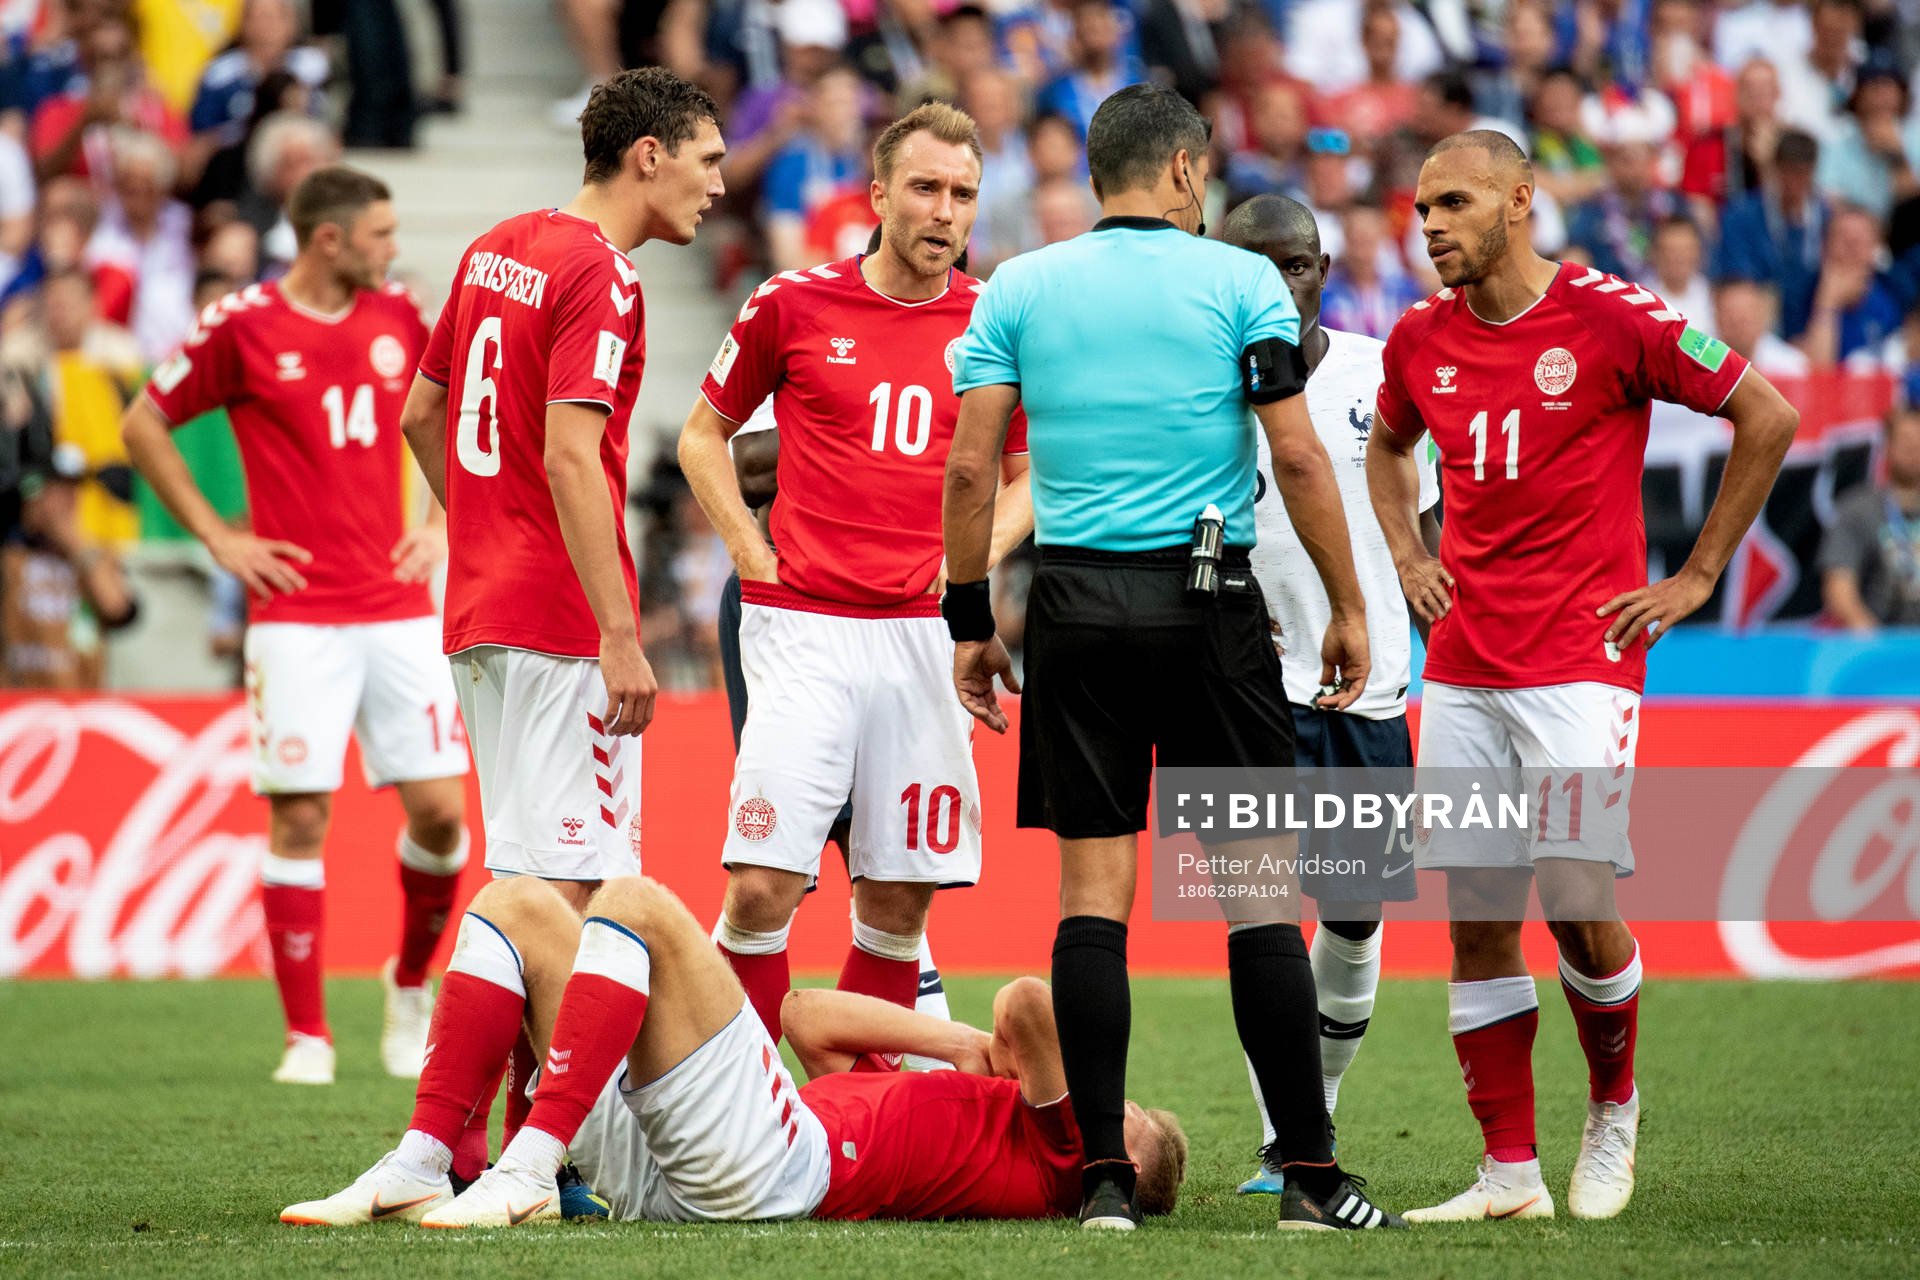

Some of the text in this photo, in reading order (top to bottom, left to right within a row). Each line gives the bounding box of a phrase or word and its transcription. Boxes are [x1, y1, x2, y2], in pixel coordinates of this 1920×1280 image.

[464, 252, 548, 309] CHRISENSEN
[456, 316, 503, 477] 6
[1544, 364, 1568, 378] DBU
[322, 384, 378, 449] 14
[869, 382, 933, 456] 10
[1469, 409, 1521, 481] 11
[423, 702, 468, 752] 14
[743, 811, 769, 826] DBU
[900, 782, 962, 855] 10
[1537, 772, 1584, 842] 11
